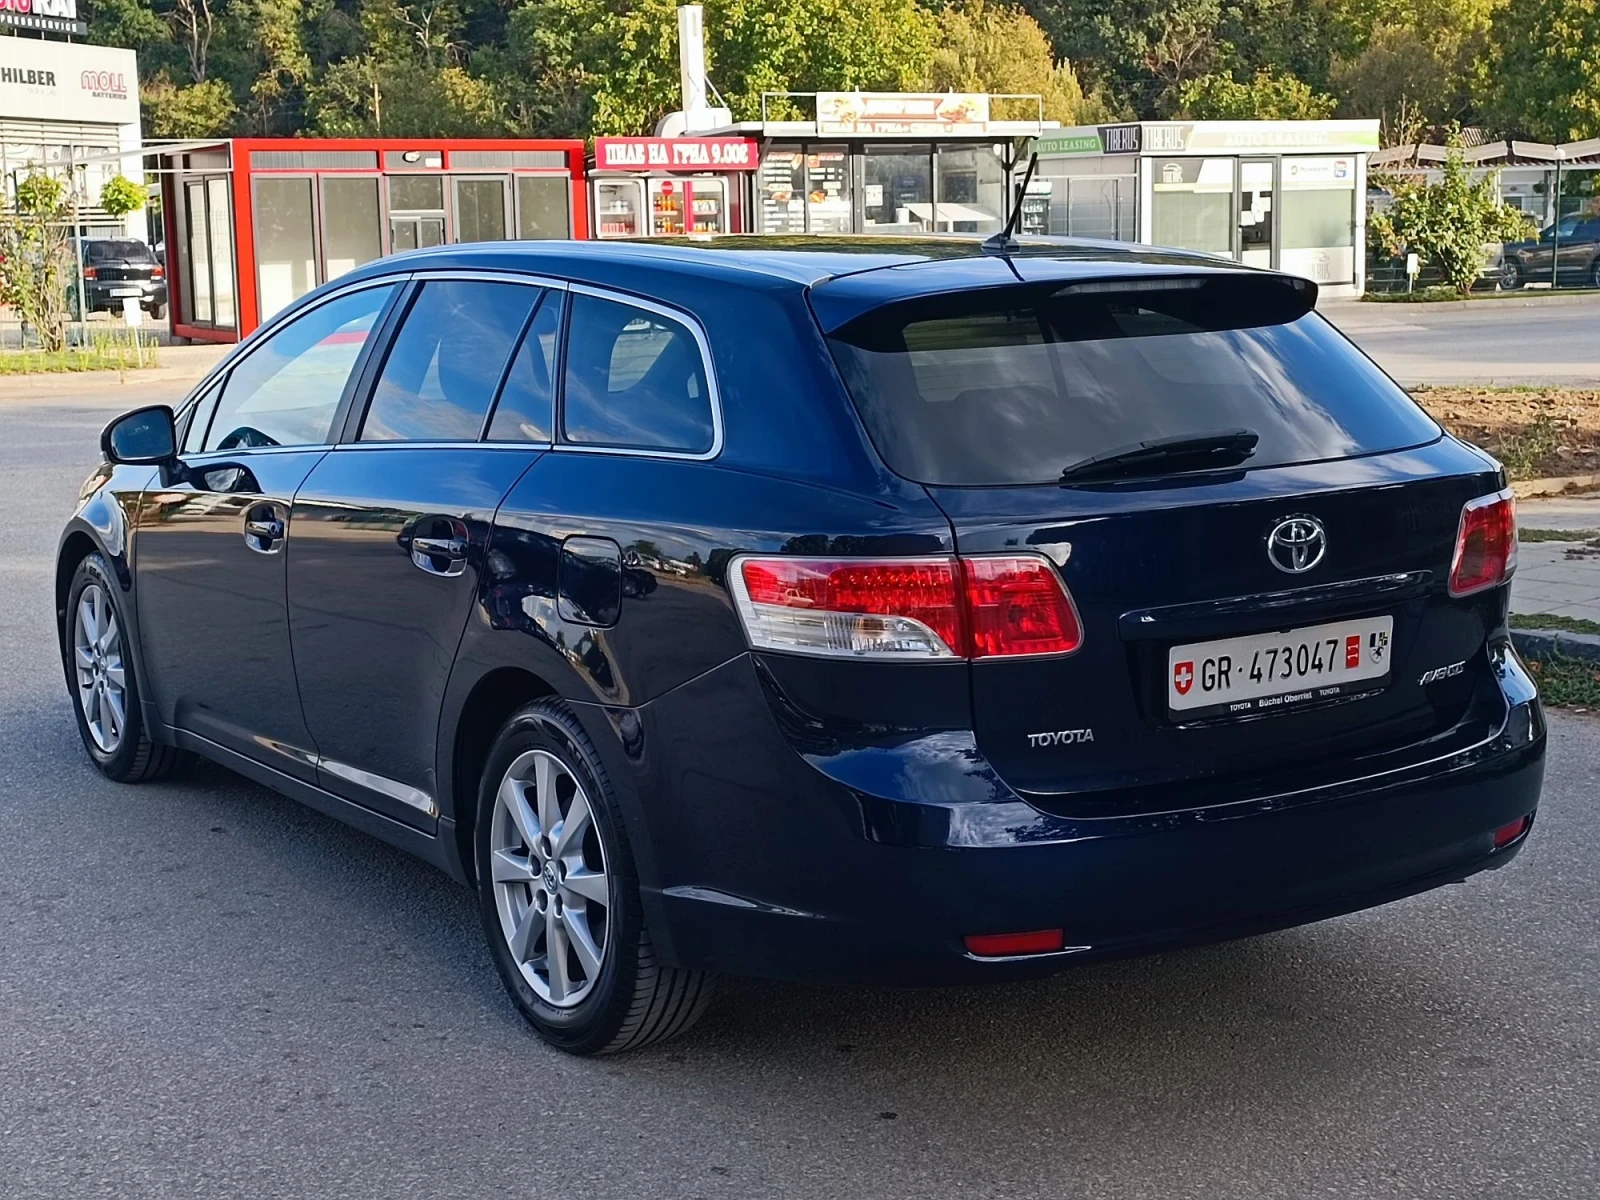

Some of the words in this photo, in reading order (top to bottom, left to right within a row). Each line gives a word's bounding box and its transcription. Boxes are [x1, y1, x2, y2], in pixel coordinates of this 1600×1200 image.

[81, 70, 127, 93] MOLL
[92, 91, 127, 100] BATTERIES
[605, 143, 645, 165] ПИЛЕ
[648, 143, 669, 165] НА
[672, 143, 710, 165] ГРИЛ
[1036, 141, 1058, 151] AUTO
[1059, 138, 1096, 151] LEASING
[1230, 702, 1252, 713] TOYOTA
[1259, 695, 1283, 708] Büchel
[1320, 687, 1341, 697] TOYOTA
[1027, 728, 1094, 748] TOYOTA
